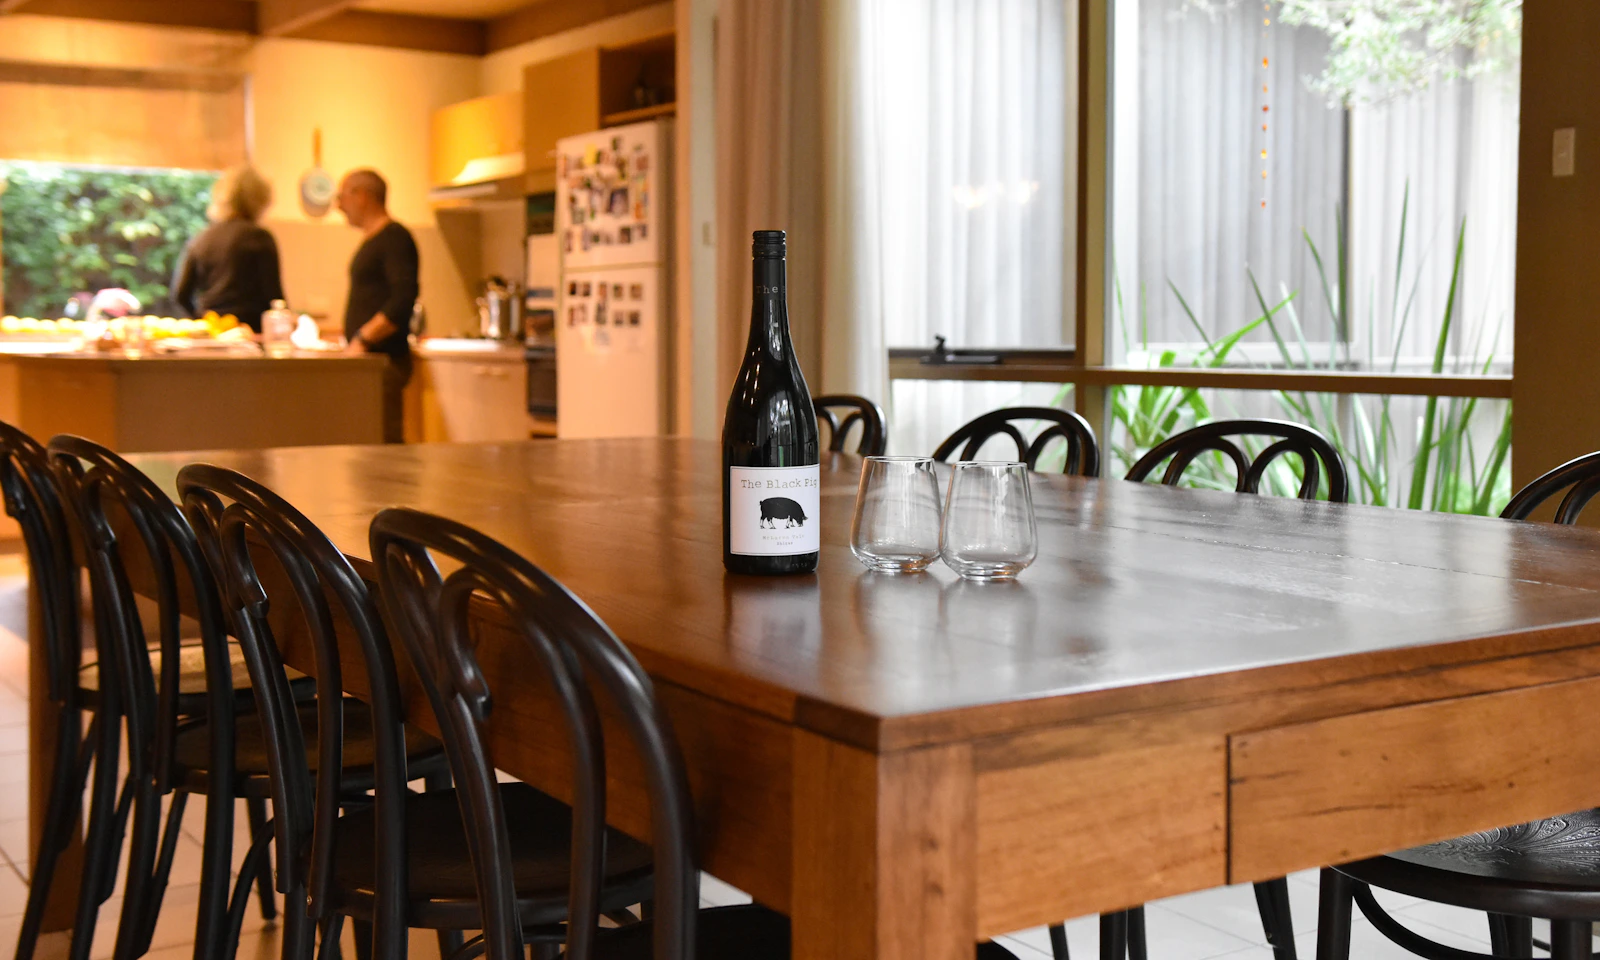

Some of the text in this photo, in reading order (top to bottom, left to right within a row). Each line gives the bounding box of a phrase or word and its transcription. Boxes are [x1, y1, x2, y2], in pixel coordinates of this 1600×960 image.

[756, 285, 778, 294] The
[741, 477, 817, 489] The Black Pig
